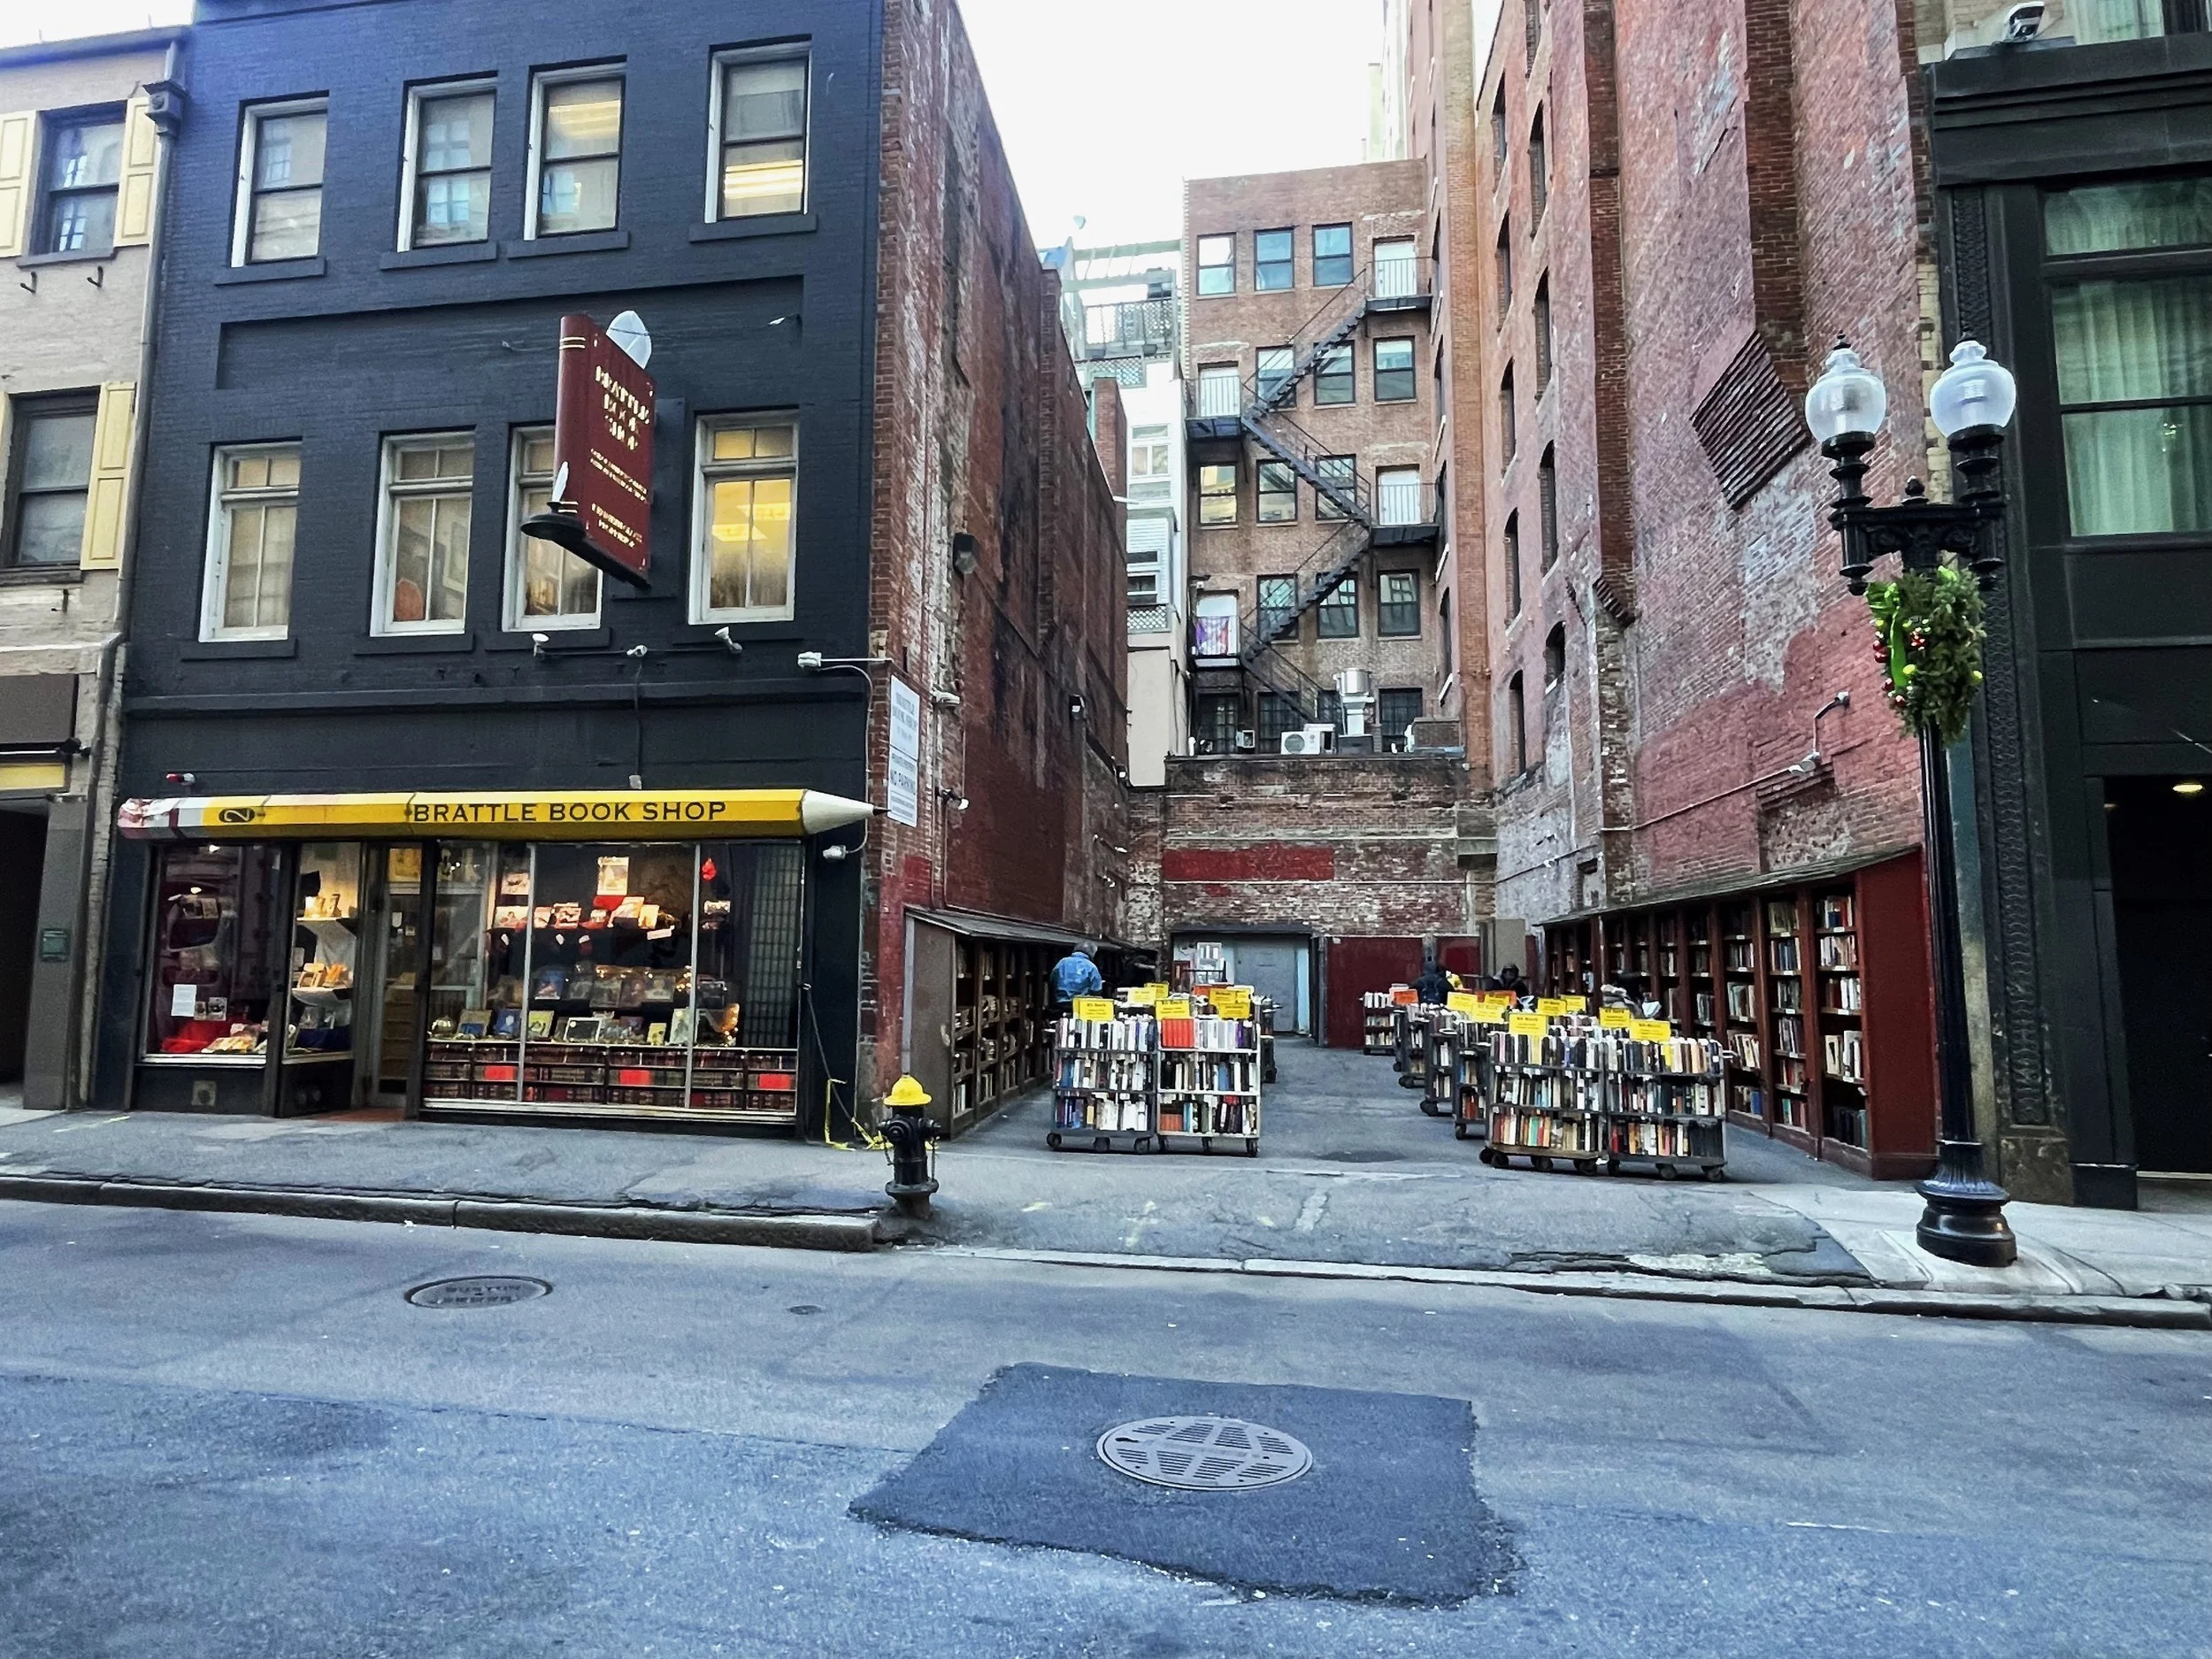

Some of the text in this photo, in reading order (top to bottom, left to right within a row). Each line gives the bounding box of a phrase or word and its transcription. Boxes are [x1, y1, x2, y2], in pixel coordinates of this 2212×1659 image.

[414, 801, 726, 822] BRATTLE BOOK SHOP
